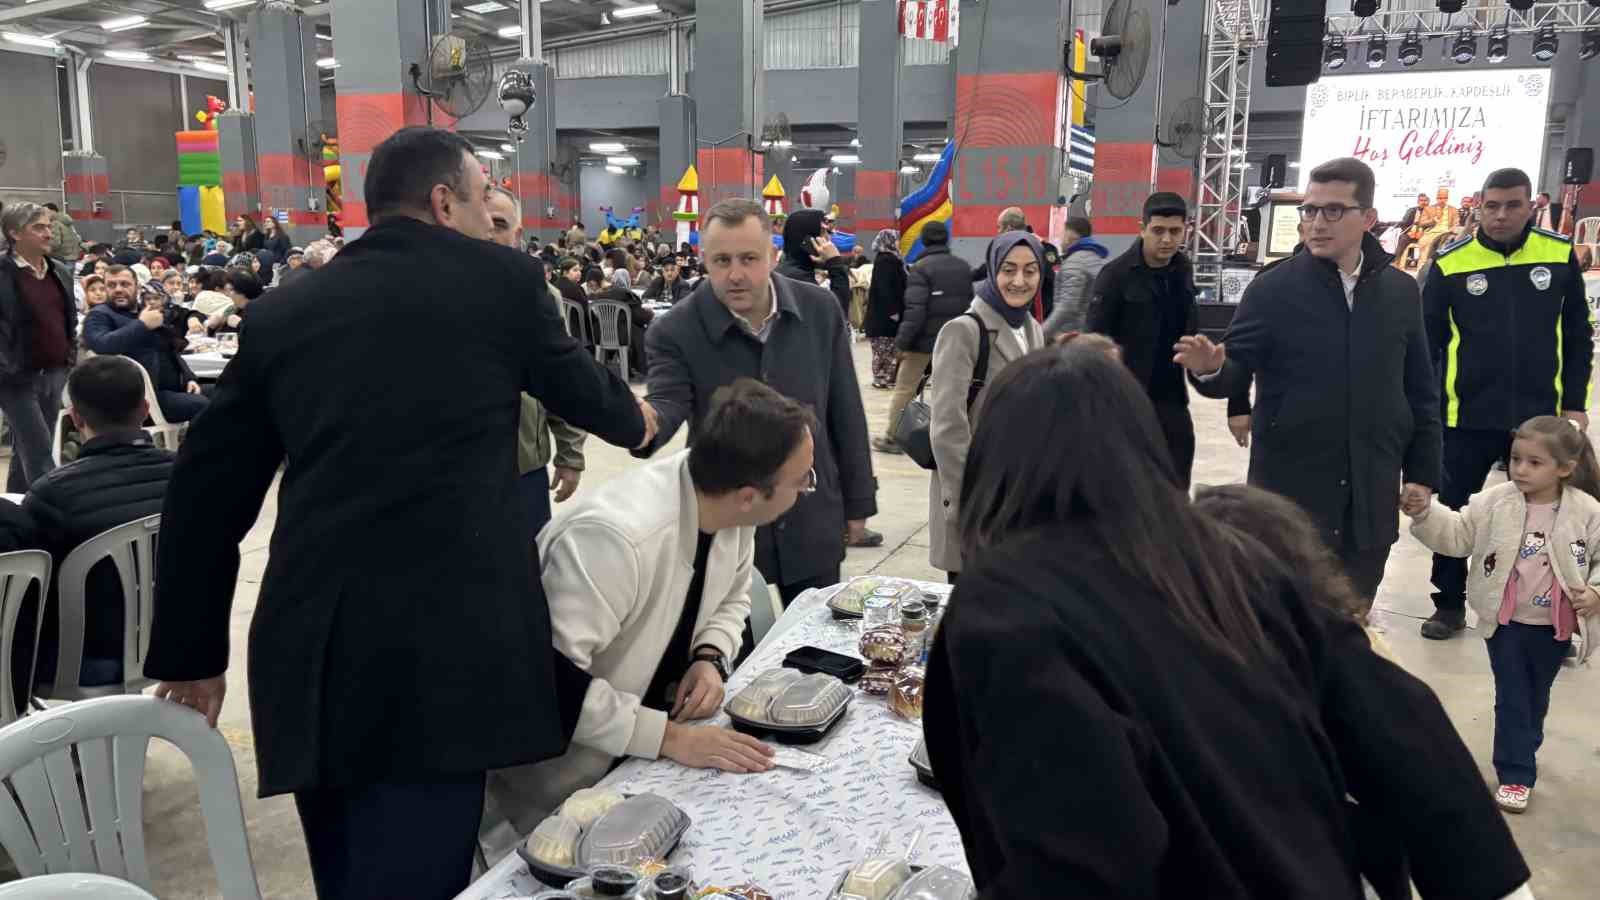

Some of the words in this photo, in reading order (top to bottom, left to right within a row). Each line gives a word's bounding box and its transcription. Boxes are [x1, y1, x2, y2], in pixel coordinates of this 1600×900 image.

[1359, 105, 1486, 130] İFTARIMIZA
[1353, 135, 1388, 167] Hoş
[1399, 128, 1484, 165] Geldiniz
